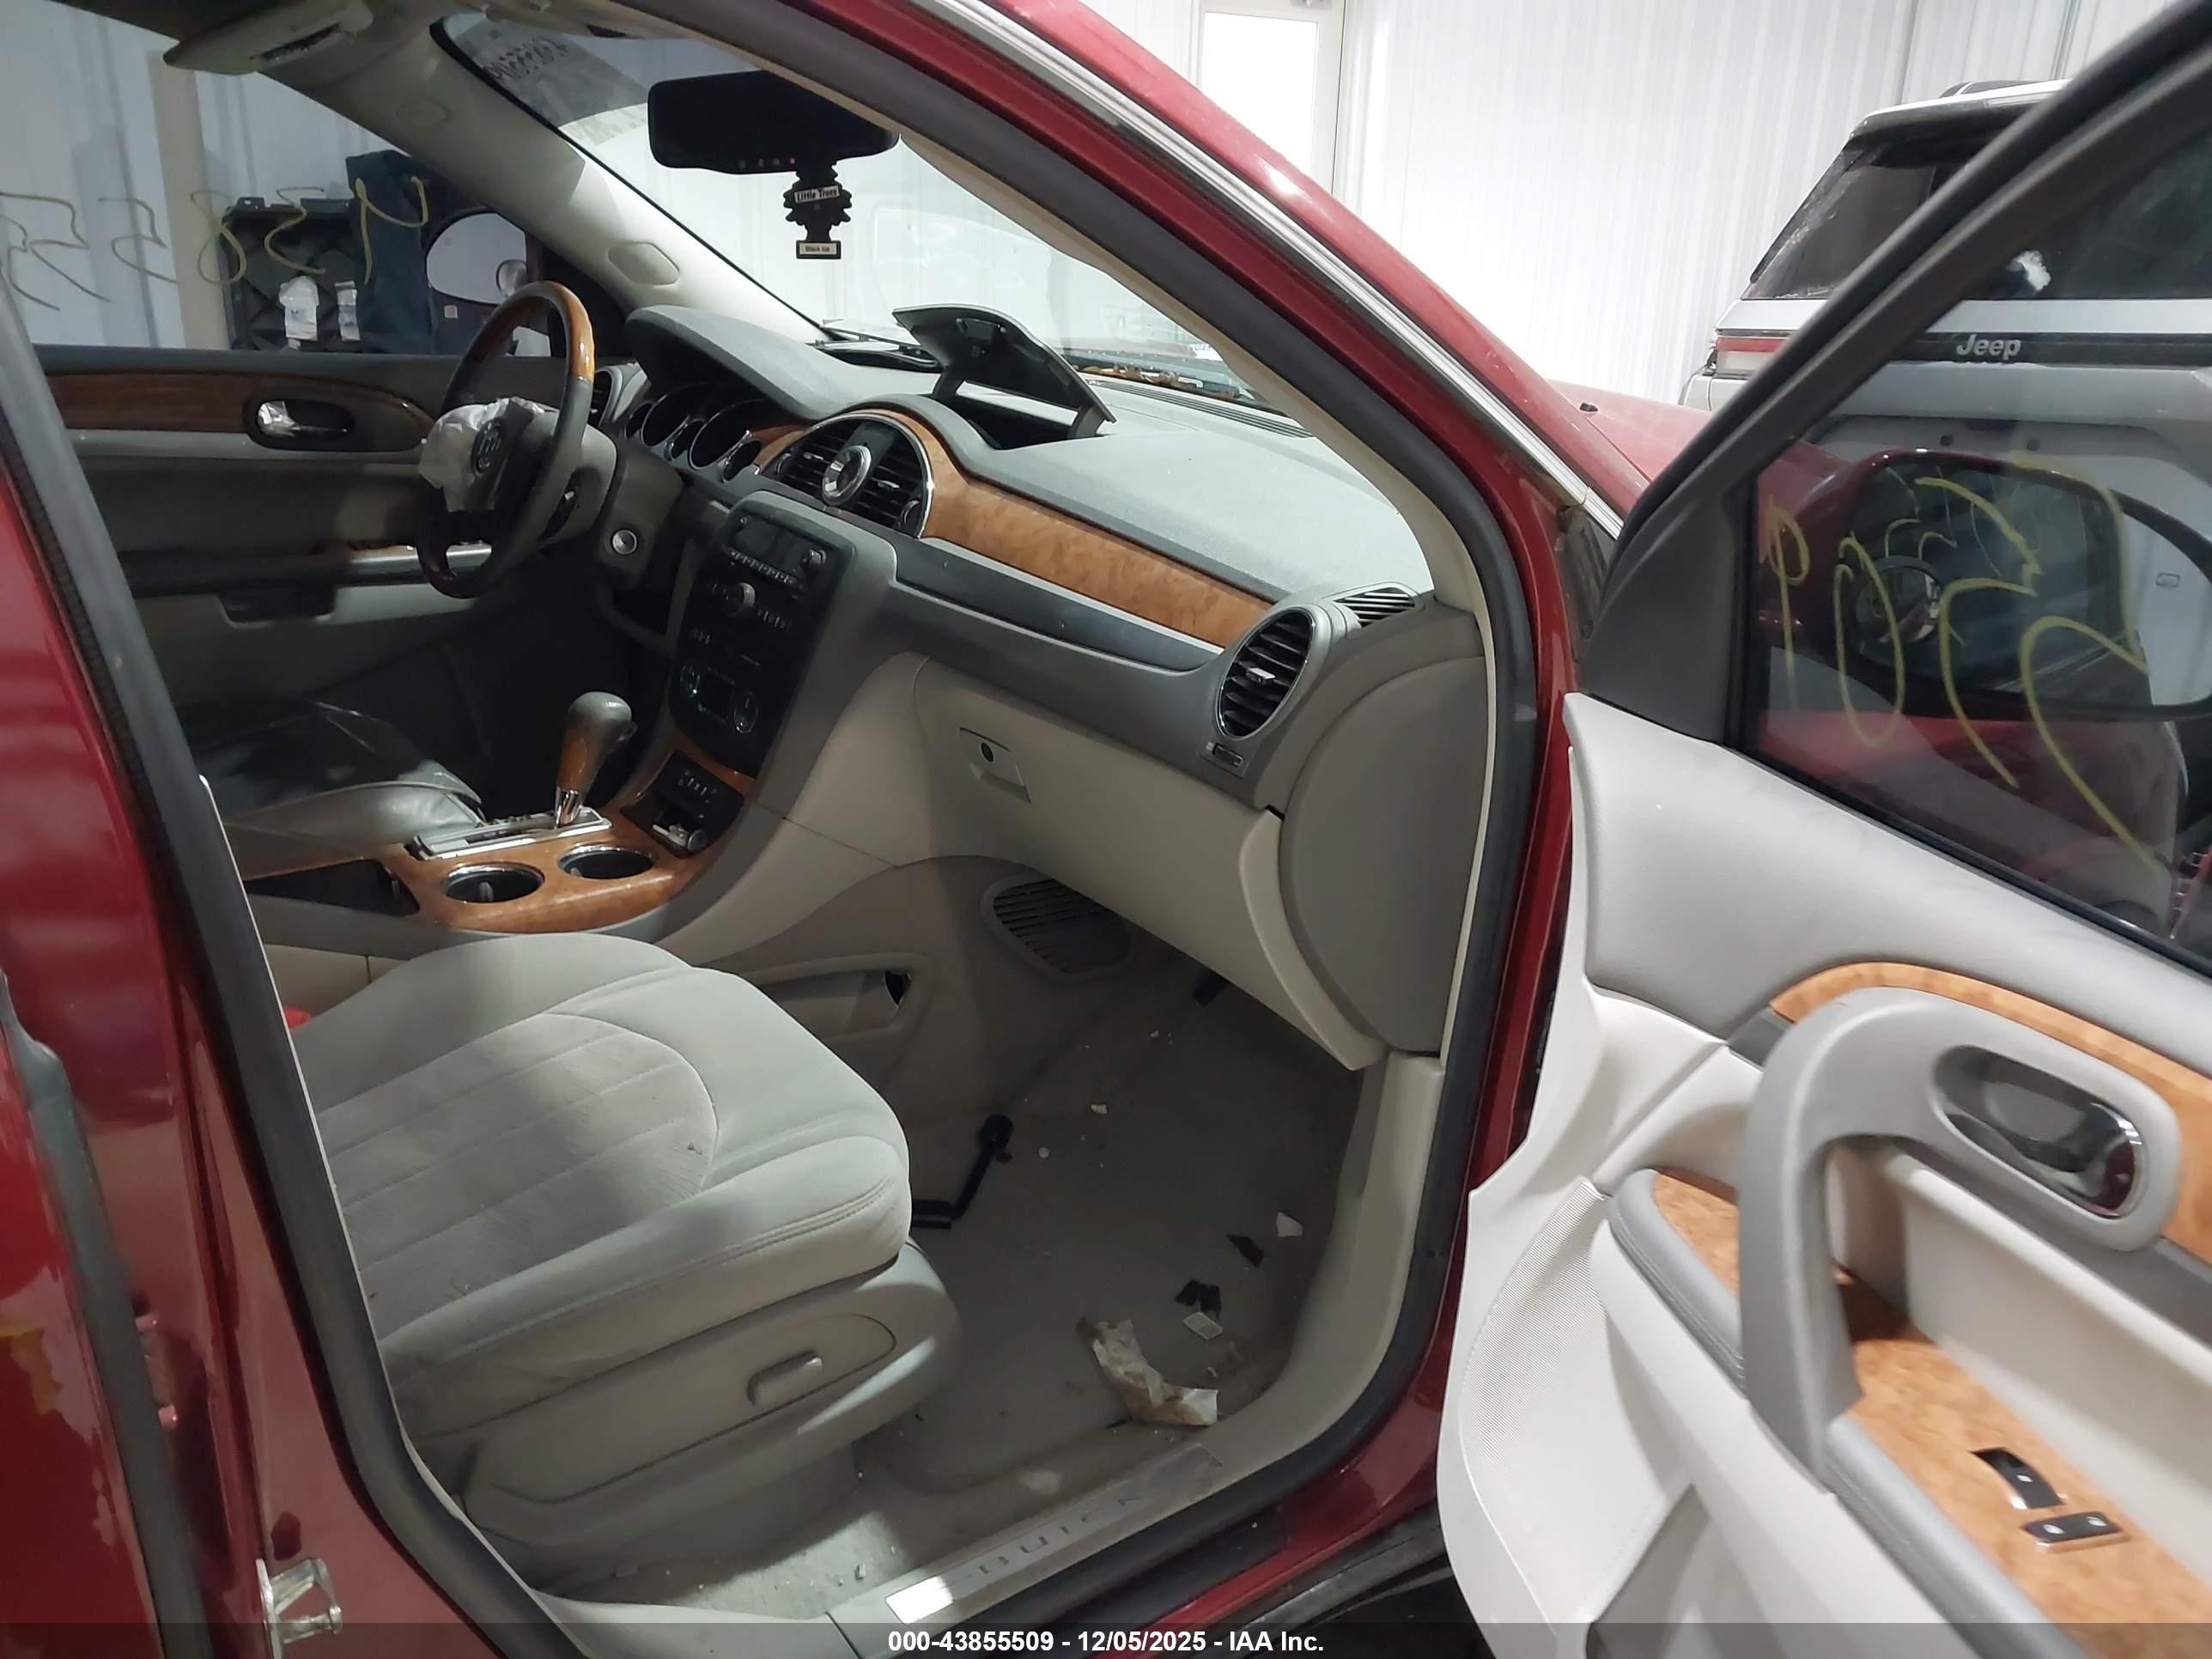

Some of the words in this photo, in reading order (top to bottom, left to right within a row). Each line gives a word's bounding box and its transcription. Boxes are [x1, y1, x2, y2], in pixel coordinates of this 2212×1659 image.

[798, 191, 817, 203] Little
[817, 187, 837, 200] Trees
[1956, 334, 2021, 361] Jeep
